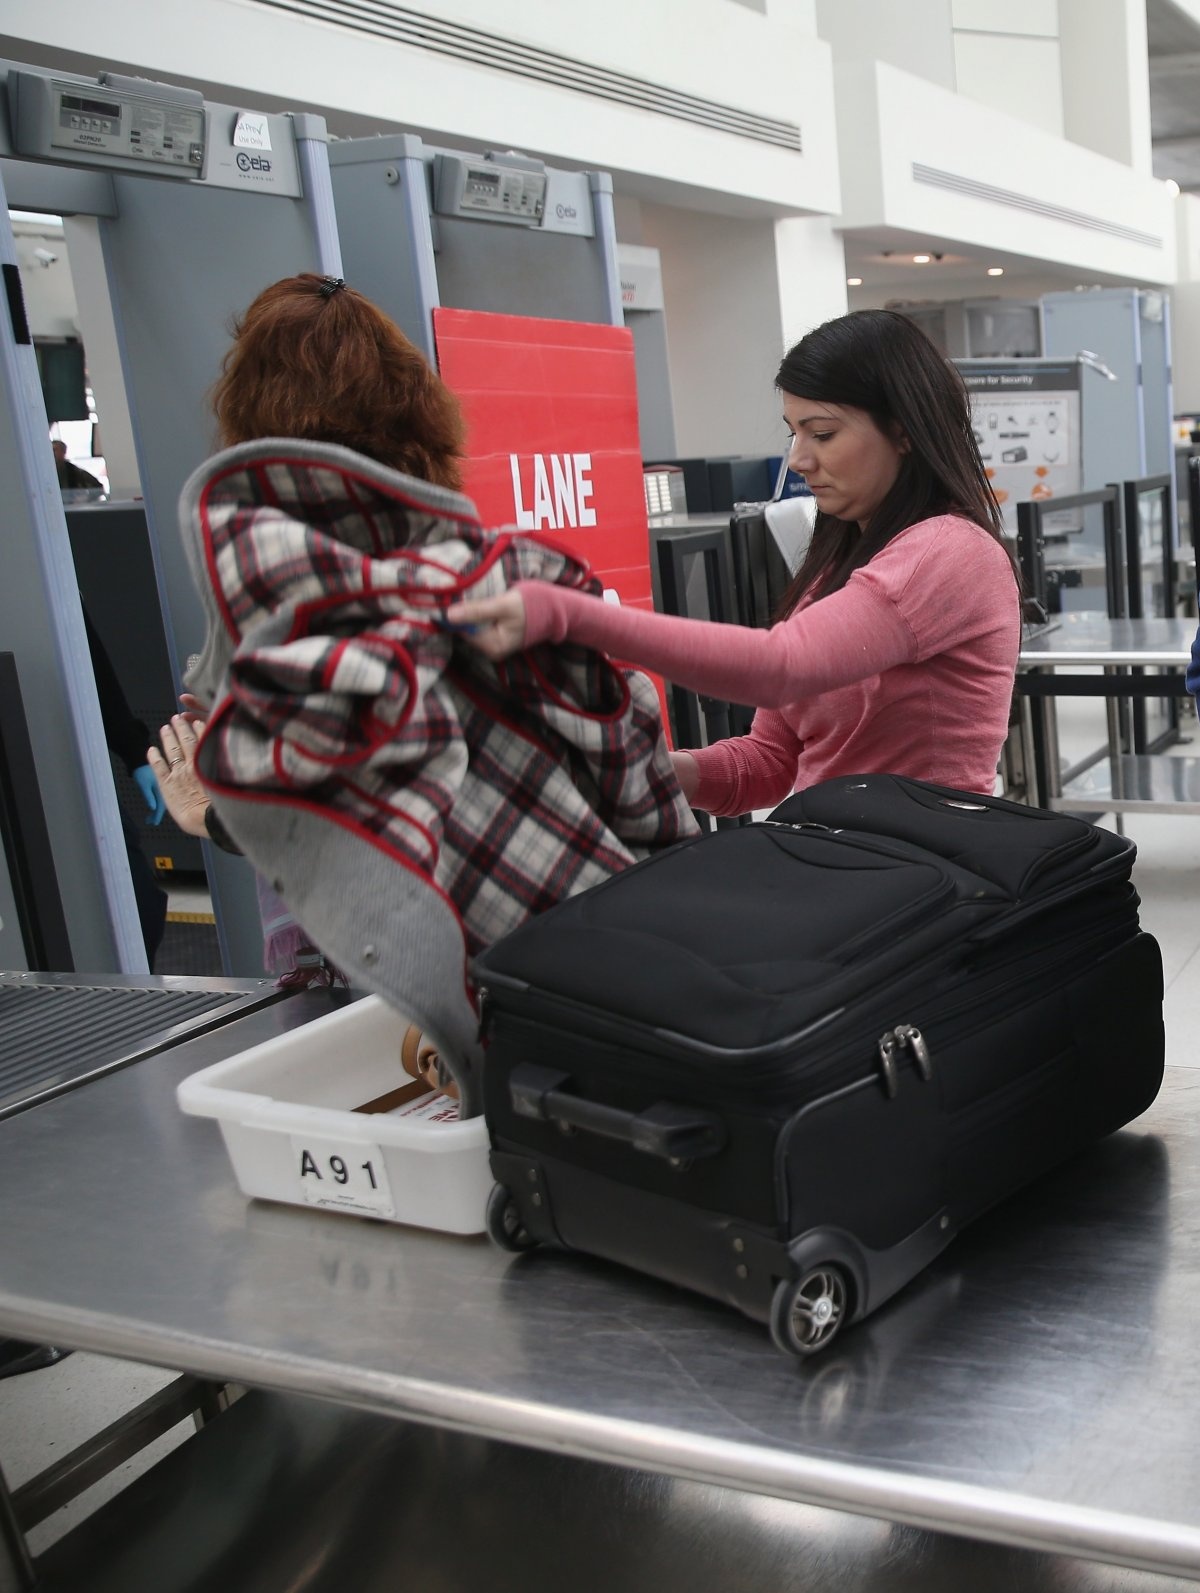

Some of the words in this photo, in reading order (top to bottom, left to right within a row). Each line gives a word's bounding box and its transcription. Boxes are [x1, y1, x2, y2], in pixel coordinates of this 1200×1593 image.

[987, 375, 1000, 386] for
[1000, 375, 1034, 386] Security
[509, 453, 598, 531] LANE
